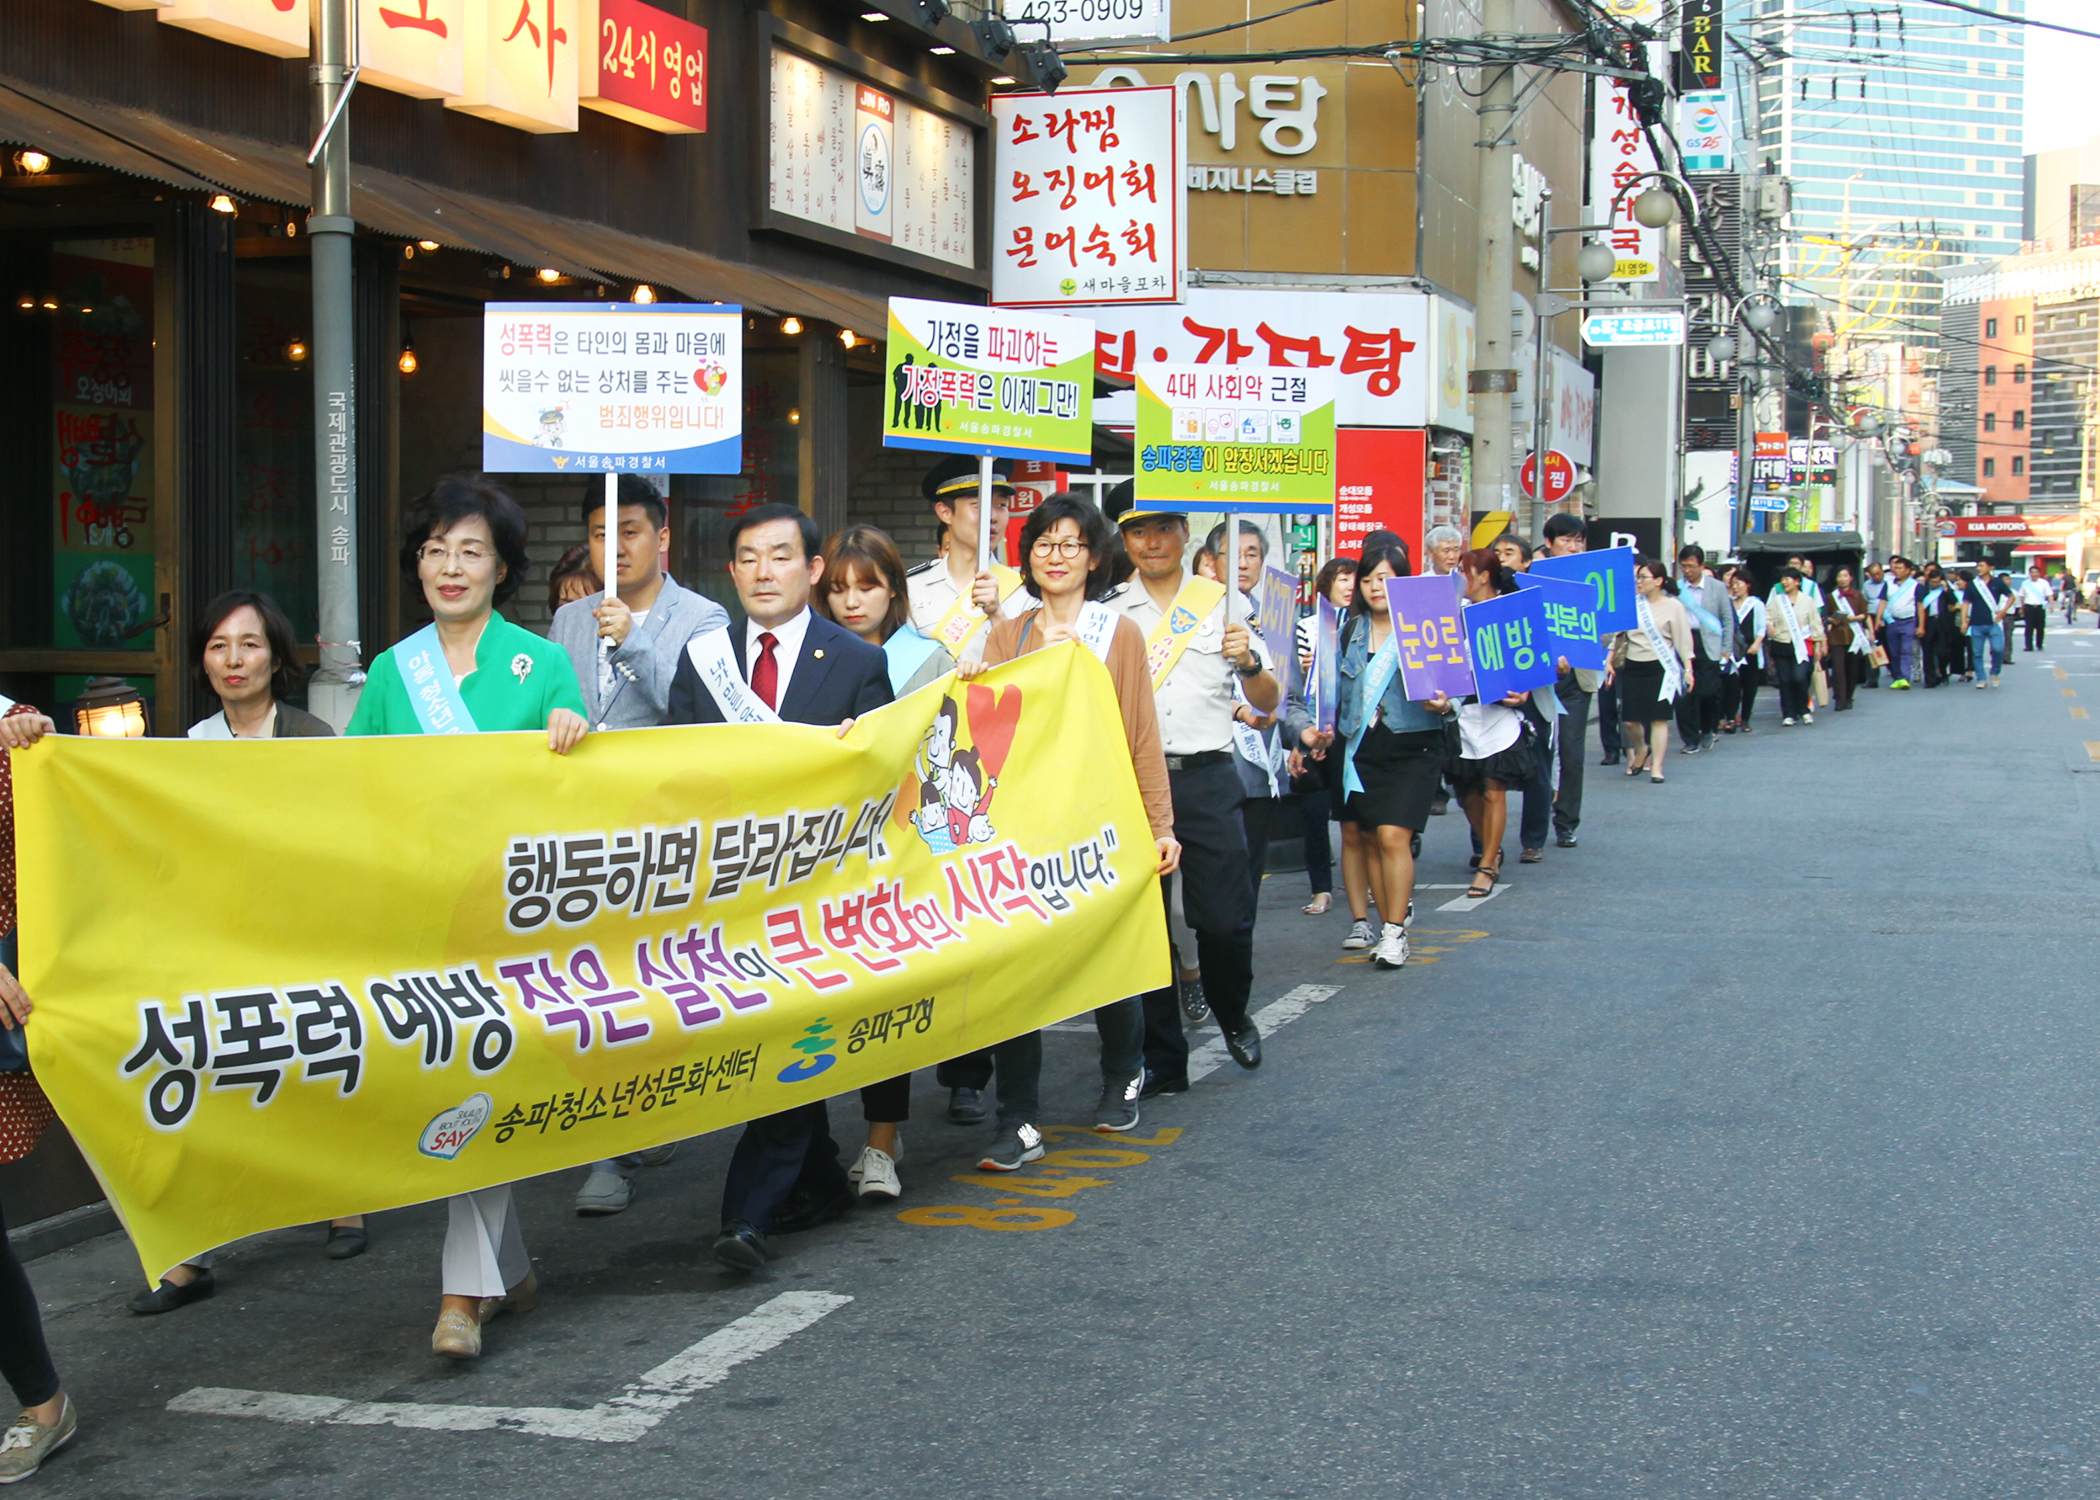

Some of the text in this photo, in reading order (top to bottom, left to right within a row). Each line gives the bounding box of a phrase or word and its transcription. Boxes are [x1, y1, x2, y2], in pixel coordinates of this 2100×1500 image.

[1022, 0, 1143, 24] 423-0909
[602, 18, 704, 106] 24시영업
[1692, 15, 1714, 73] BAR
[1012, 105, 1120, 153] 소라찜
[1686, 136, 1723, 149] GS25
[1013, 160, 1157, 210] 오징어회
[1006, 219, 1157, 268] 문어숙회
[1082, 275, 1167, 294] 새마을포차
[499, 323, 725, 356] 성폭력은 타인의 몸과 마음에
[926, 319, 979, 359] 가정을
[988, 326, 1058, 367] 파괴하는
[499, 369, 688, 394] 씻을수 없는 상처를 주는
[901, 366, 1078, 418] 가정폭력은 이제그만!
[1167, 374, 1307, 402] 4대 사회악 근절
[600, 405, 724, 430] 범죄행위입니다!
[959, 421, 1033, 438] 서울송파경찰서
[328, 391, 351, 567] 국제관광도시 송파
[575, 456, 666, 470] 서울송파경찰서
[1141, 445, 1329, 475] 송파경찰이 앞장서겠습니다
[1209, 480, 1280, 492] 서울송파경찰서
[1967, 522, 1986, 532] KIA
[1986, 522, 2027, 532] MOTORS
[1262, 571, 1297, 639] CCTV
[1398, 612, 1465, 670] 눈으로
[1476, 616, 1551, 671] 예방,
[507, 826, 698, 928] 행동하면
[124, 984, 362, 1126] 성폭력
[370, 968, 513, 1071] 예방
[499, 948, 650, 1050] 작은
[638, 926, 791, 1027] 실천이
[767, 909, 849, 989] 큰
[822, 881, 963, 972] 변화의
[846, 996, 936, 1055] 송파구청
[493, 1043, 762, 1144] 송파청소년성문화센터
[430, 1127, 474, 1151] SAY
